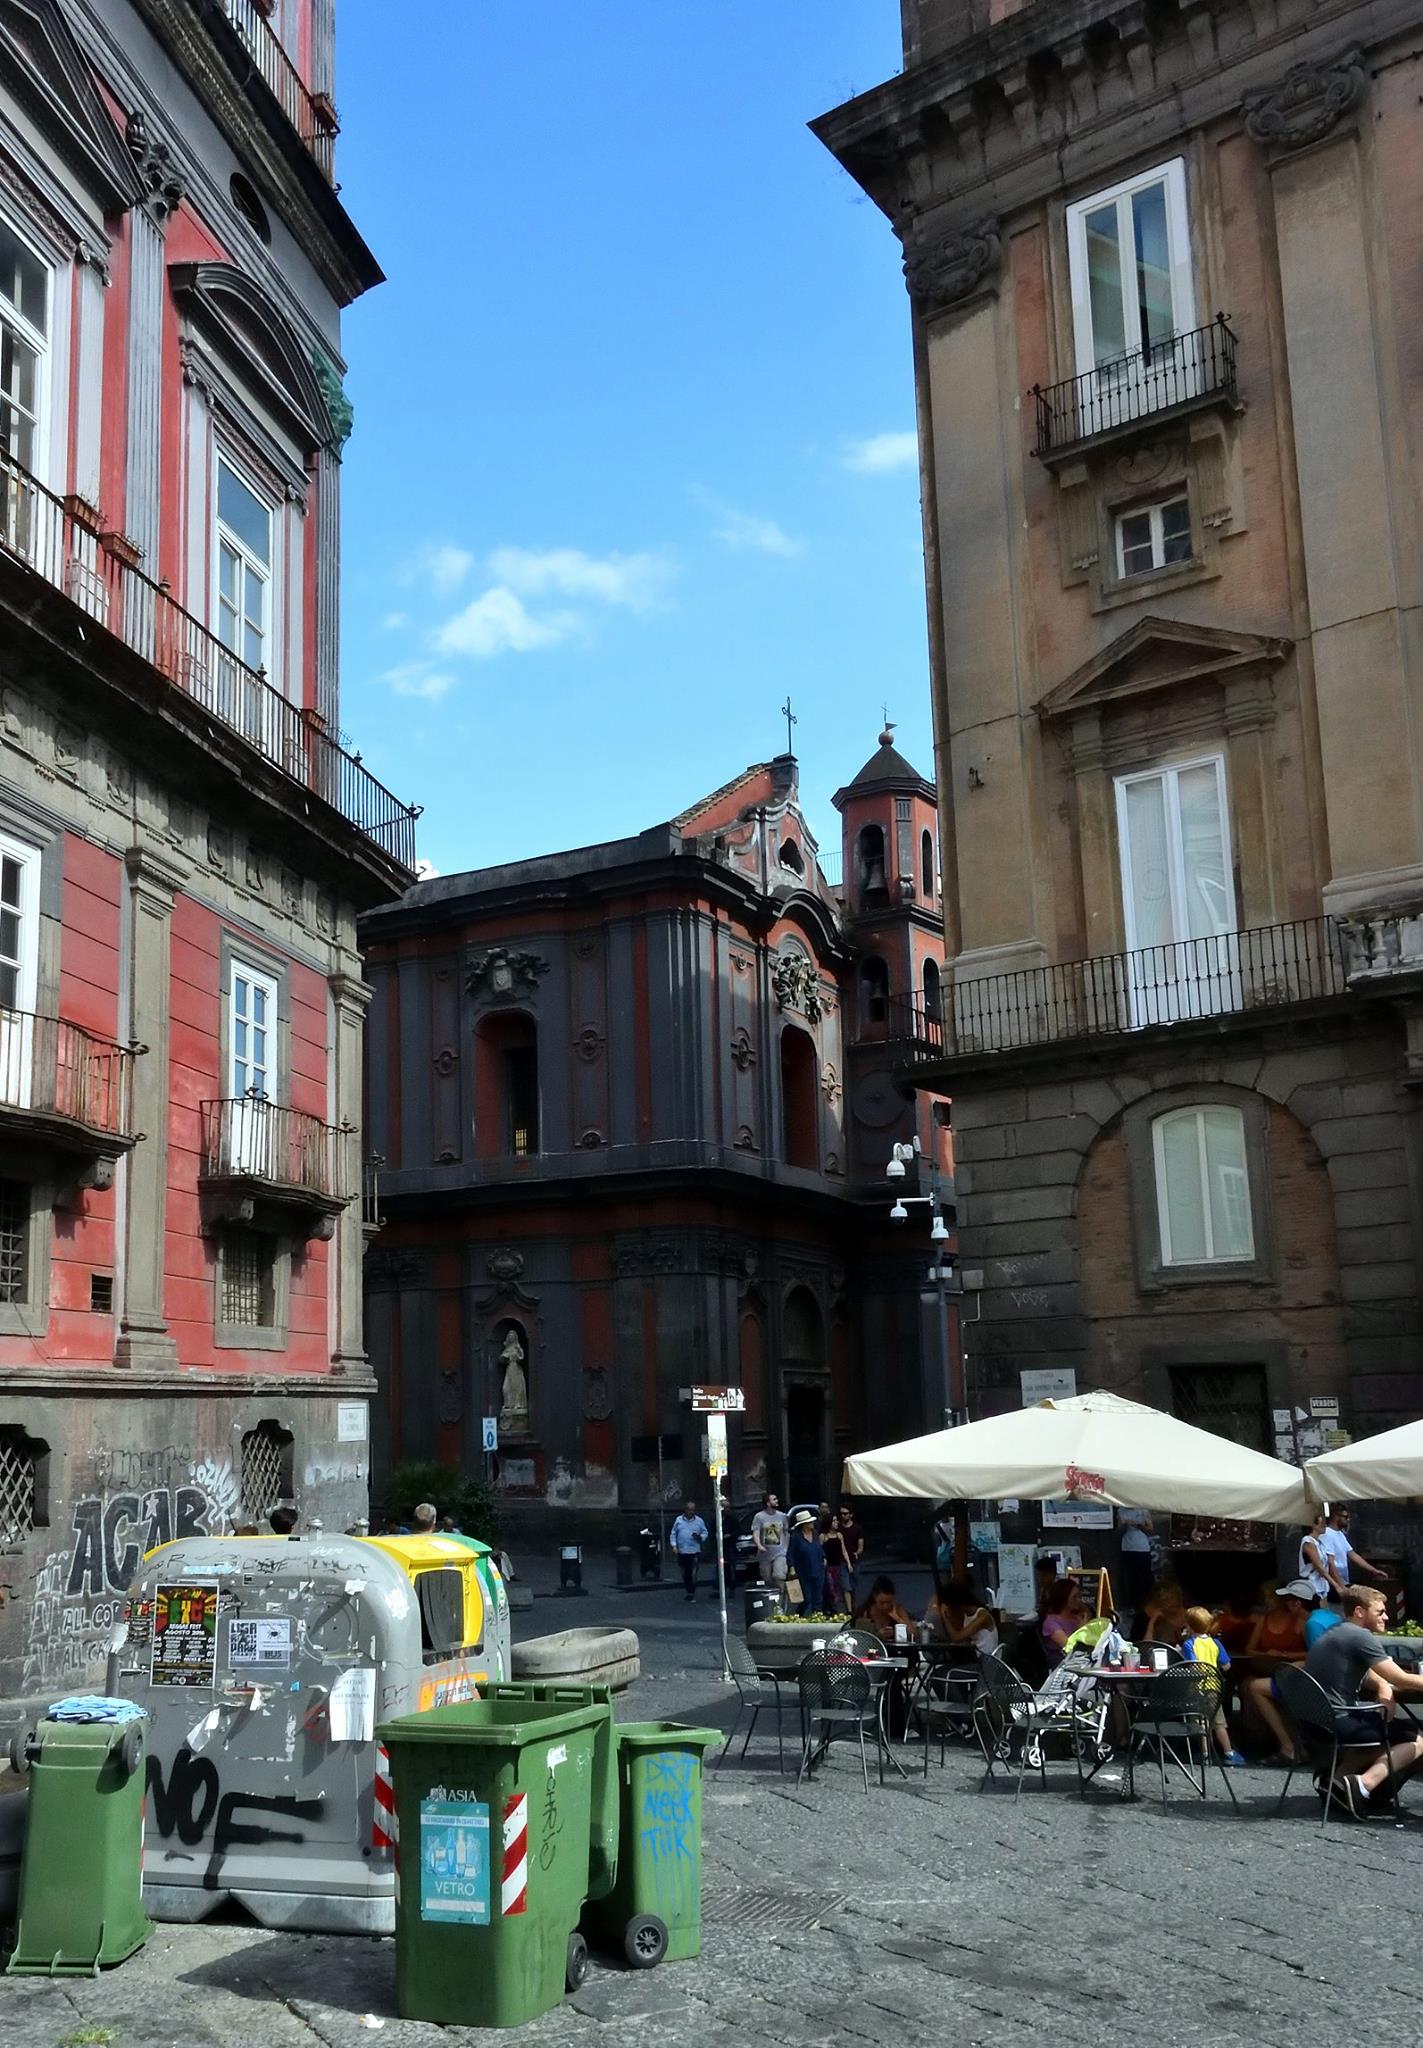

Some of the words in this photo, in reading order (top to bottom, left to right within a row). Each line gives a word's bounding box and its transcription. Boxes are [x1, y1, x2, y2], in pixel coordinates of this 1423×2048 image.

[64, 1484, 208, 1598] ACAB
[447, 1789, 477, 1803] ASIA
[434, 1880, 476, 1897] VETRO
